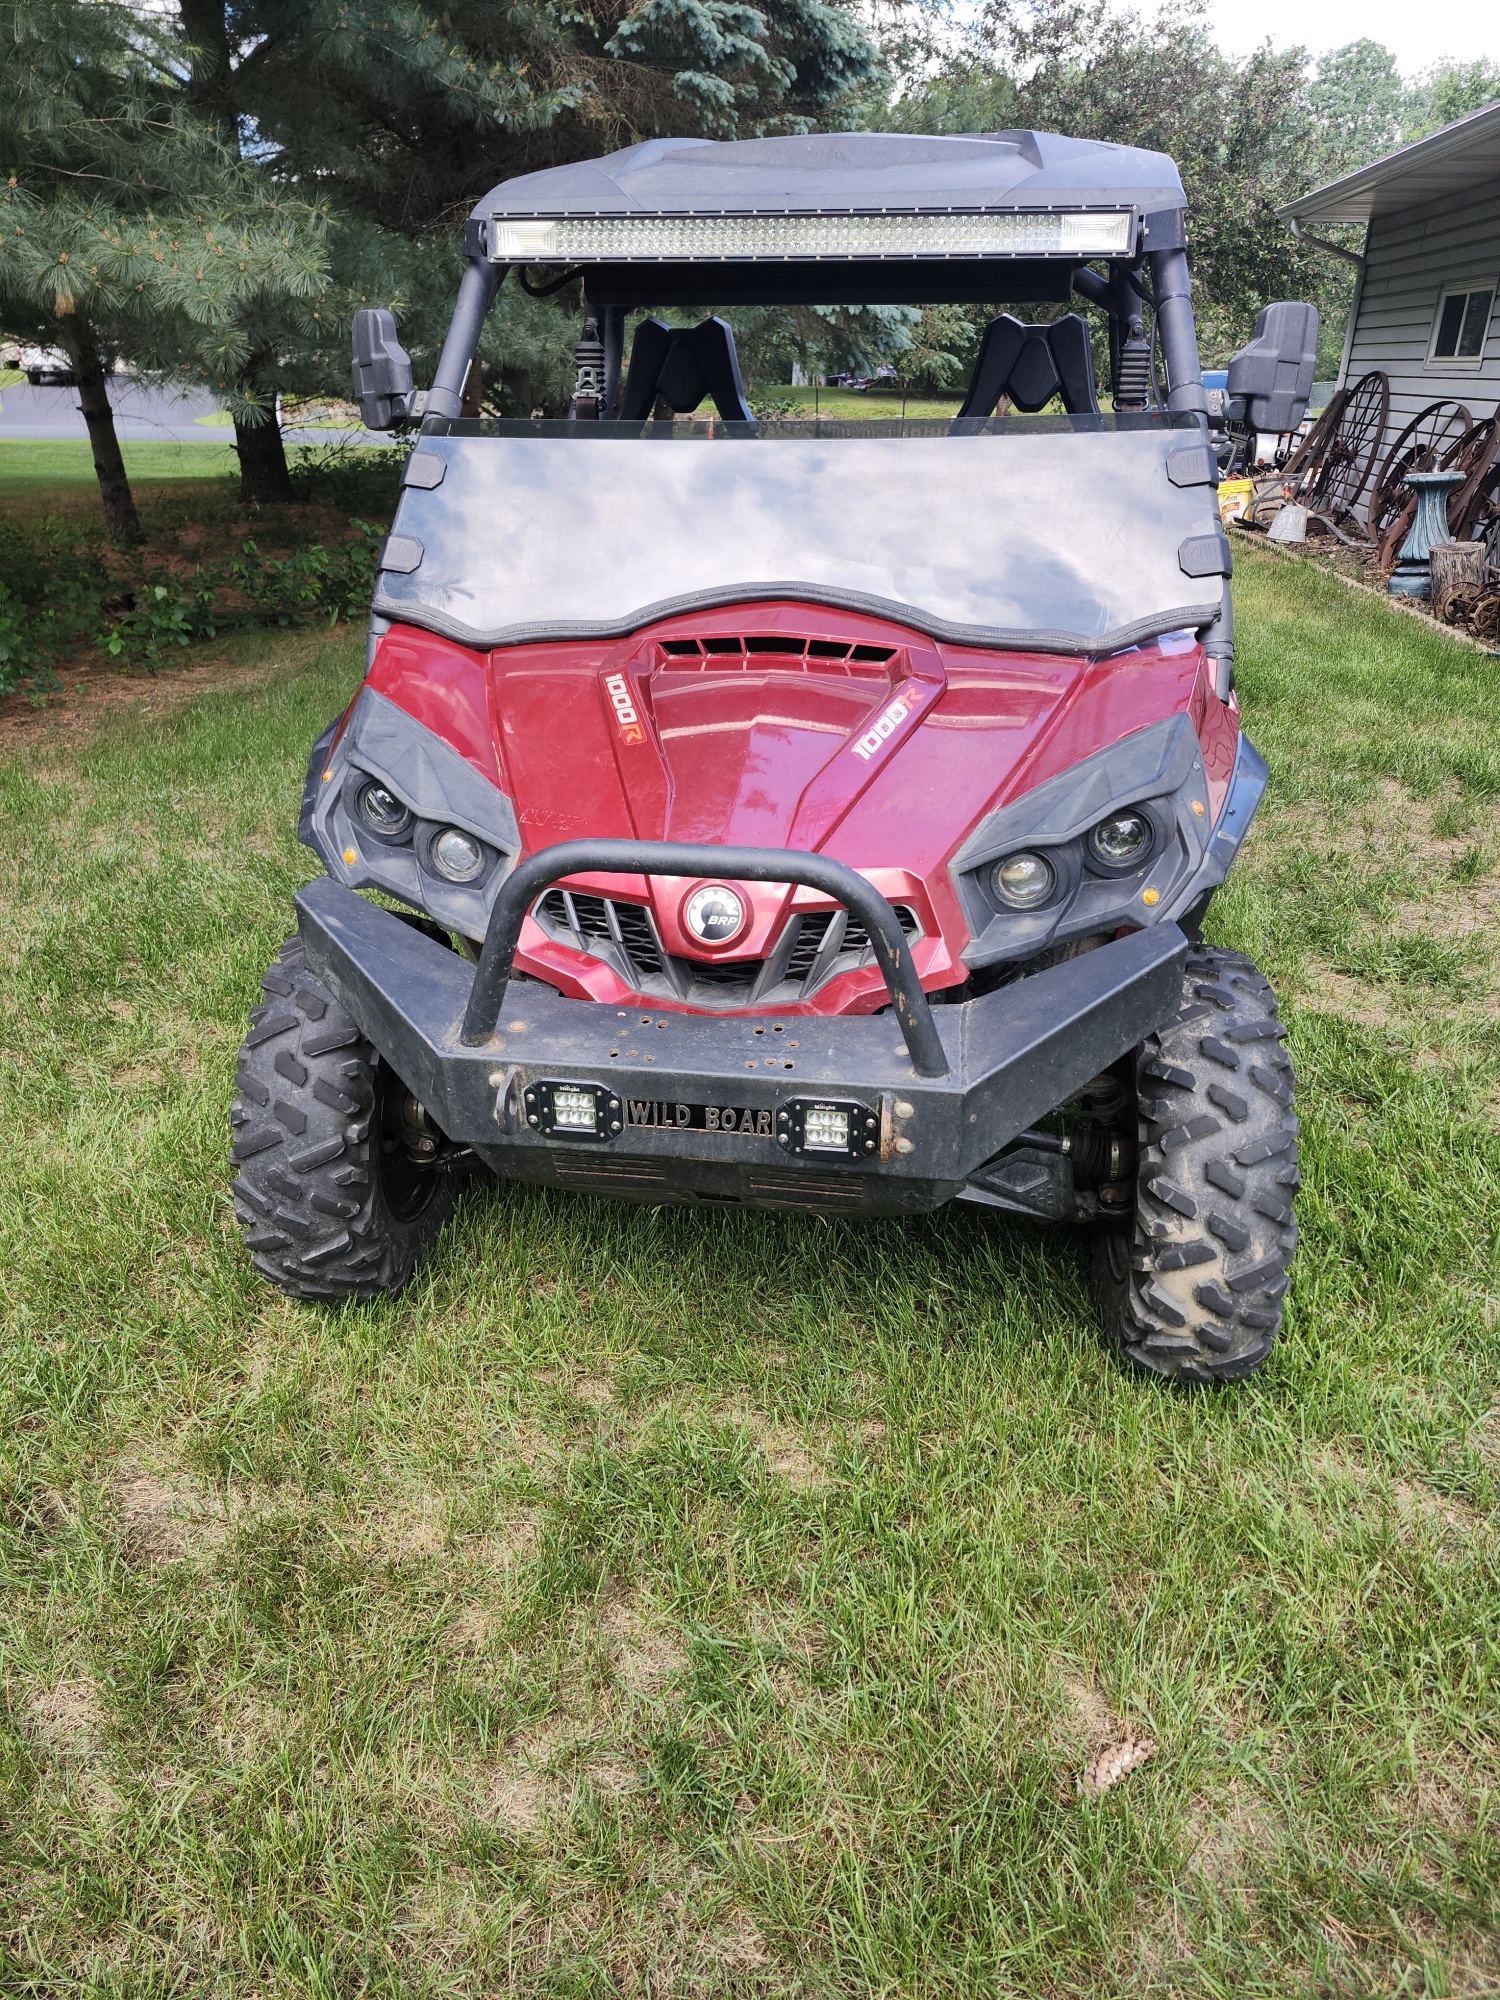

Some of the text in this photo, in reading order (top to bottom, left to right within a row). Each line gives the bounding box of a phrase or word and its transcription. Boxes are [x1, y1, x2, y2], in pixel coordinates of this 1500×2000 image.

[605, 673, 643, 744] 1000R
[852, 687, 925, 761] 1000R
[707, 915, 738, 926] BRP
[629, 1100, 772, 1135] WILD BOAR
